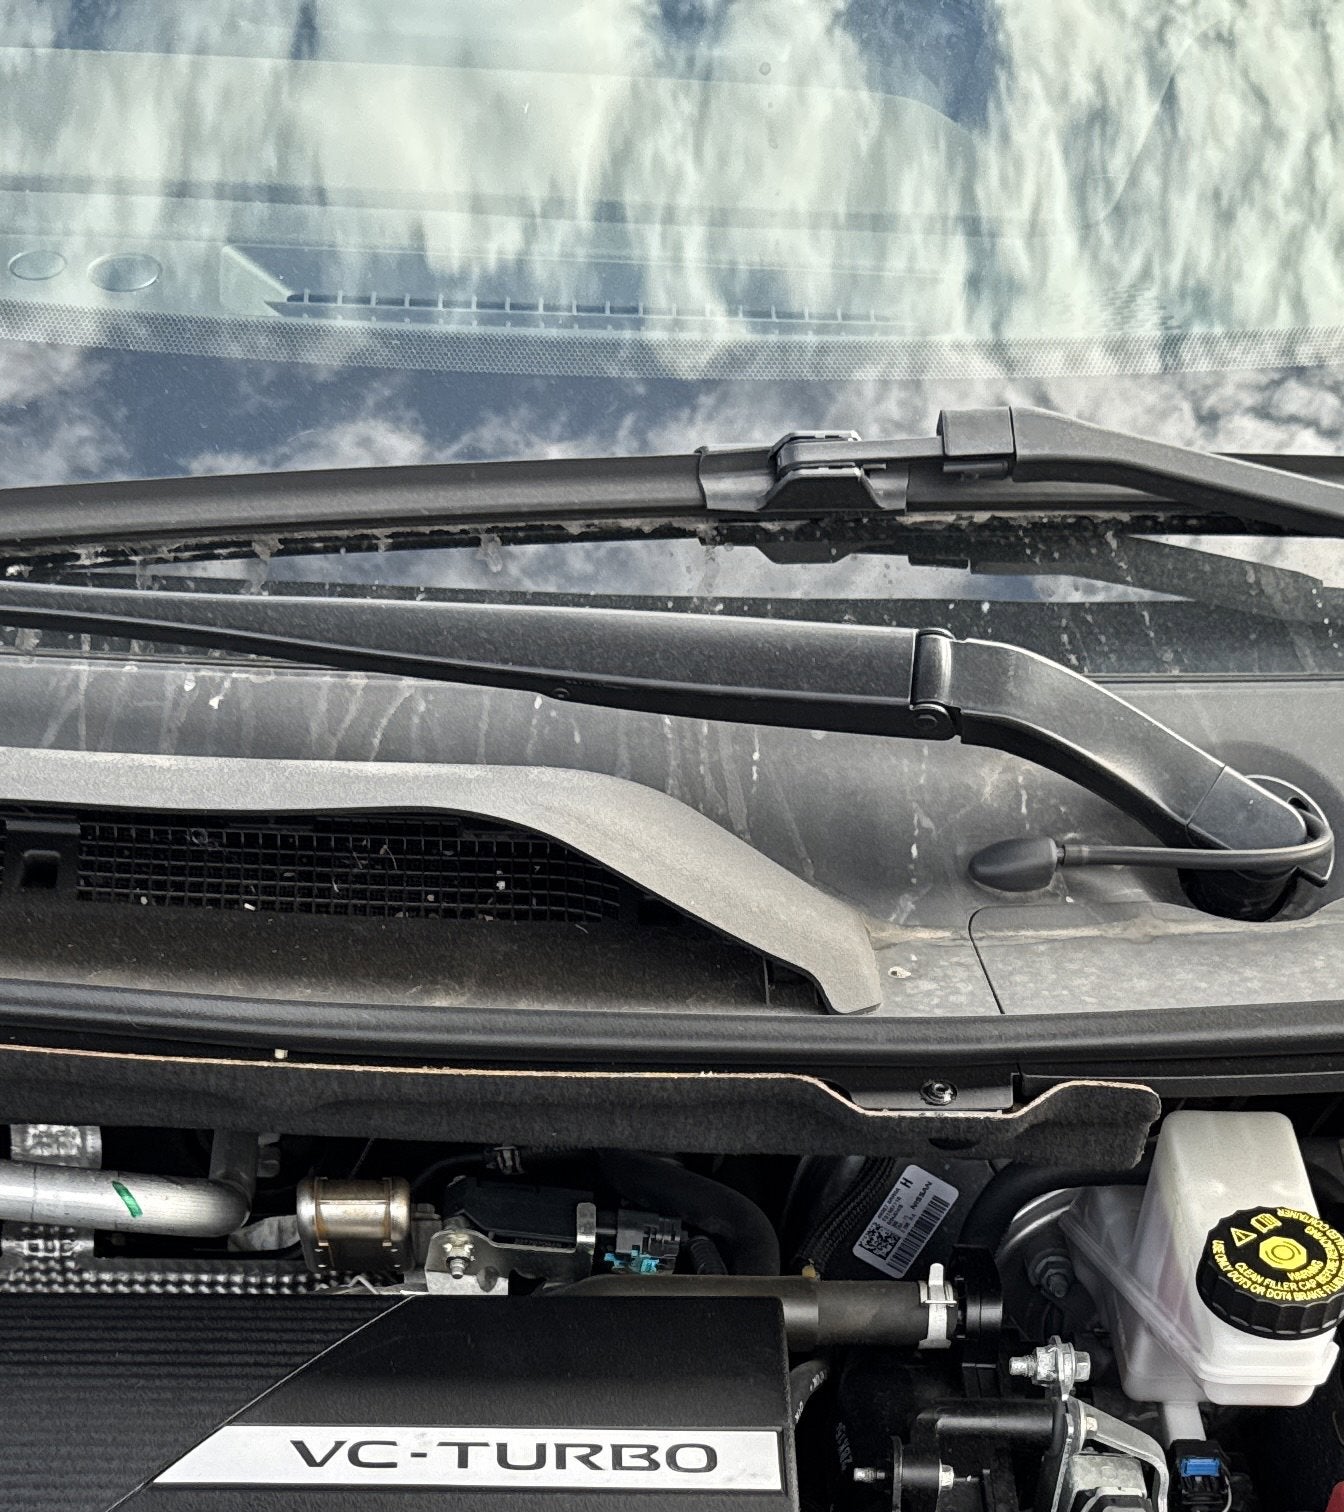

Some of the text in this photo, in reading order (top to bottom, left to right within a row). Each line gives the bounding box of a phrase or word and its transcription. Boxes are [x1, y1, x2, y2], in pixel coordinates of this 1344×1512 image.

[900, 1177, 914, 1189] H
[911, 1181, 933, 1210] NISSAN
[1235, 1262, 1264, 1284] CLEAN
[1263, 1277, 1298, 1290] FILLER
[1299, 1279, 1317, 1291] CAP
[1294, 1288, 1327, 1301] BRAKE
[290, 1439, 719, 1474] VC-TURBO
